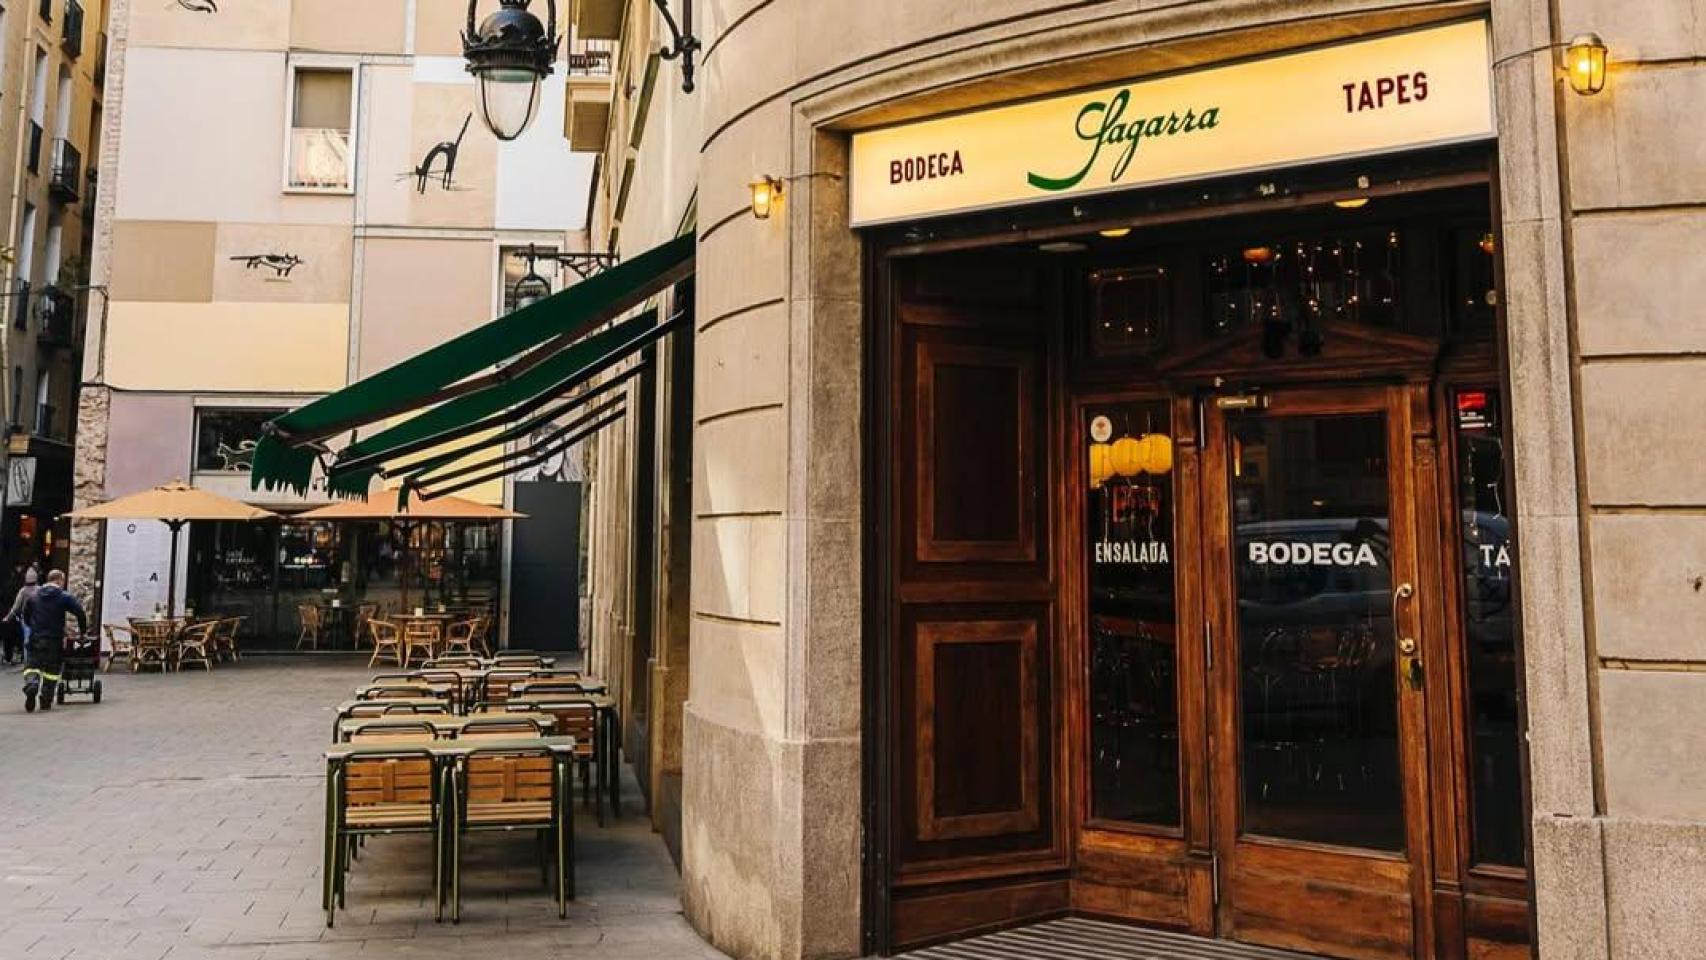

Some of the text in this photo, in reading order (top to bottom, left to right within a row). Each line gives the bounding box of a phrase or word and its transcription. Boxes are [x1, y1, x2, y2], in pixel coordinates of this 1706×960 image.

[889, 71, 1428, 191] BODEGA Sagarra TAPES
[1095, 540, 1169, 563] ENSALADA
[1248, 542, 1378, 566] BODEGA
